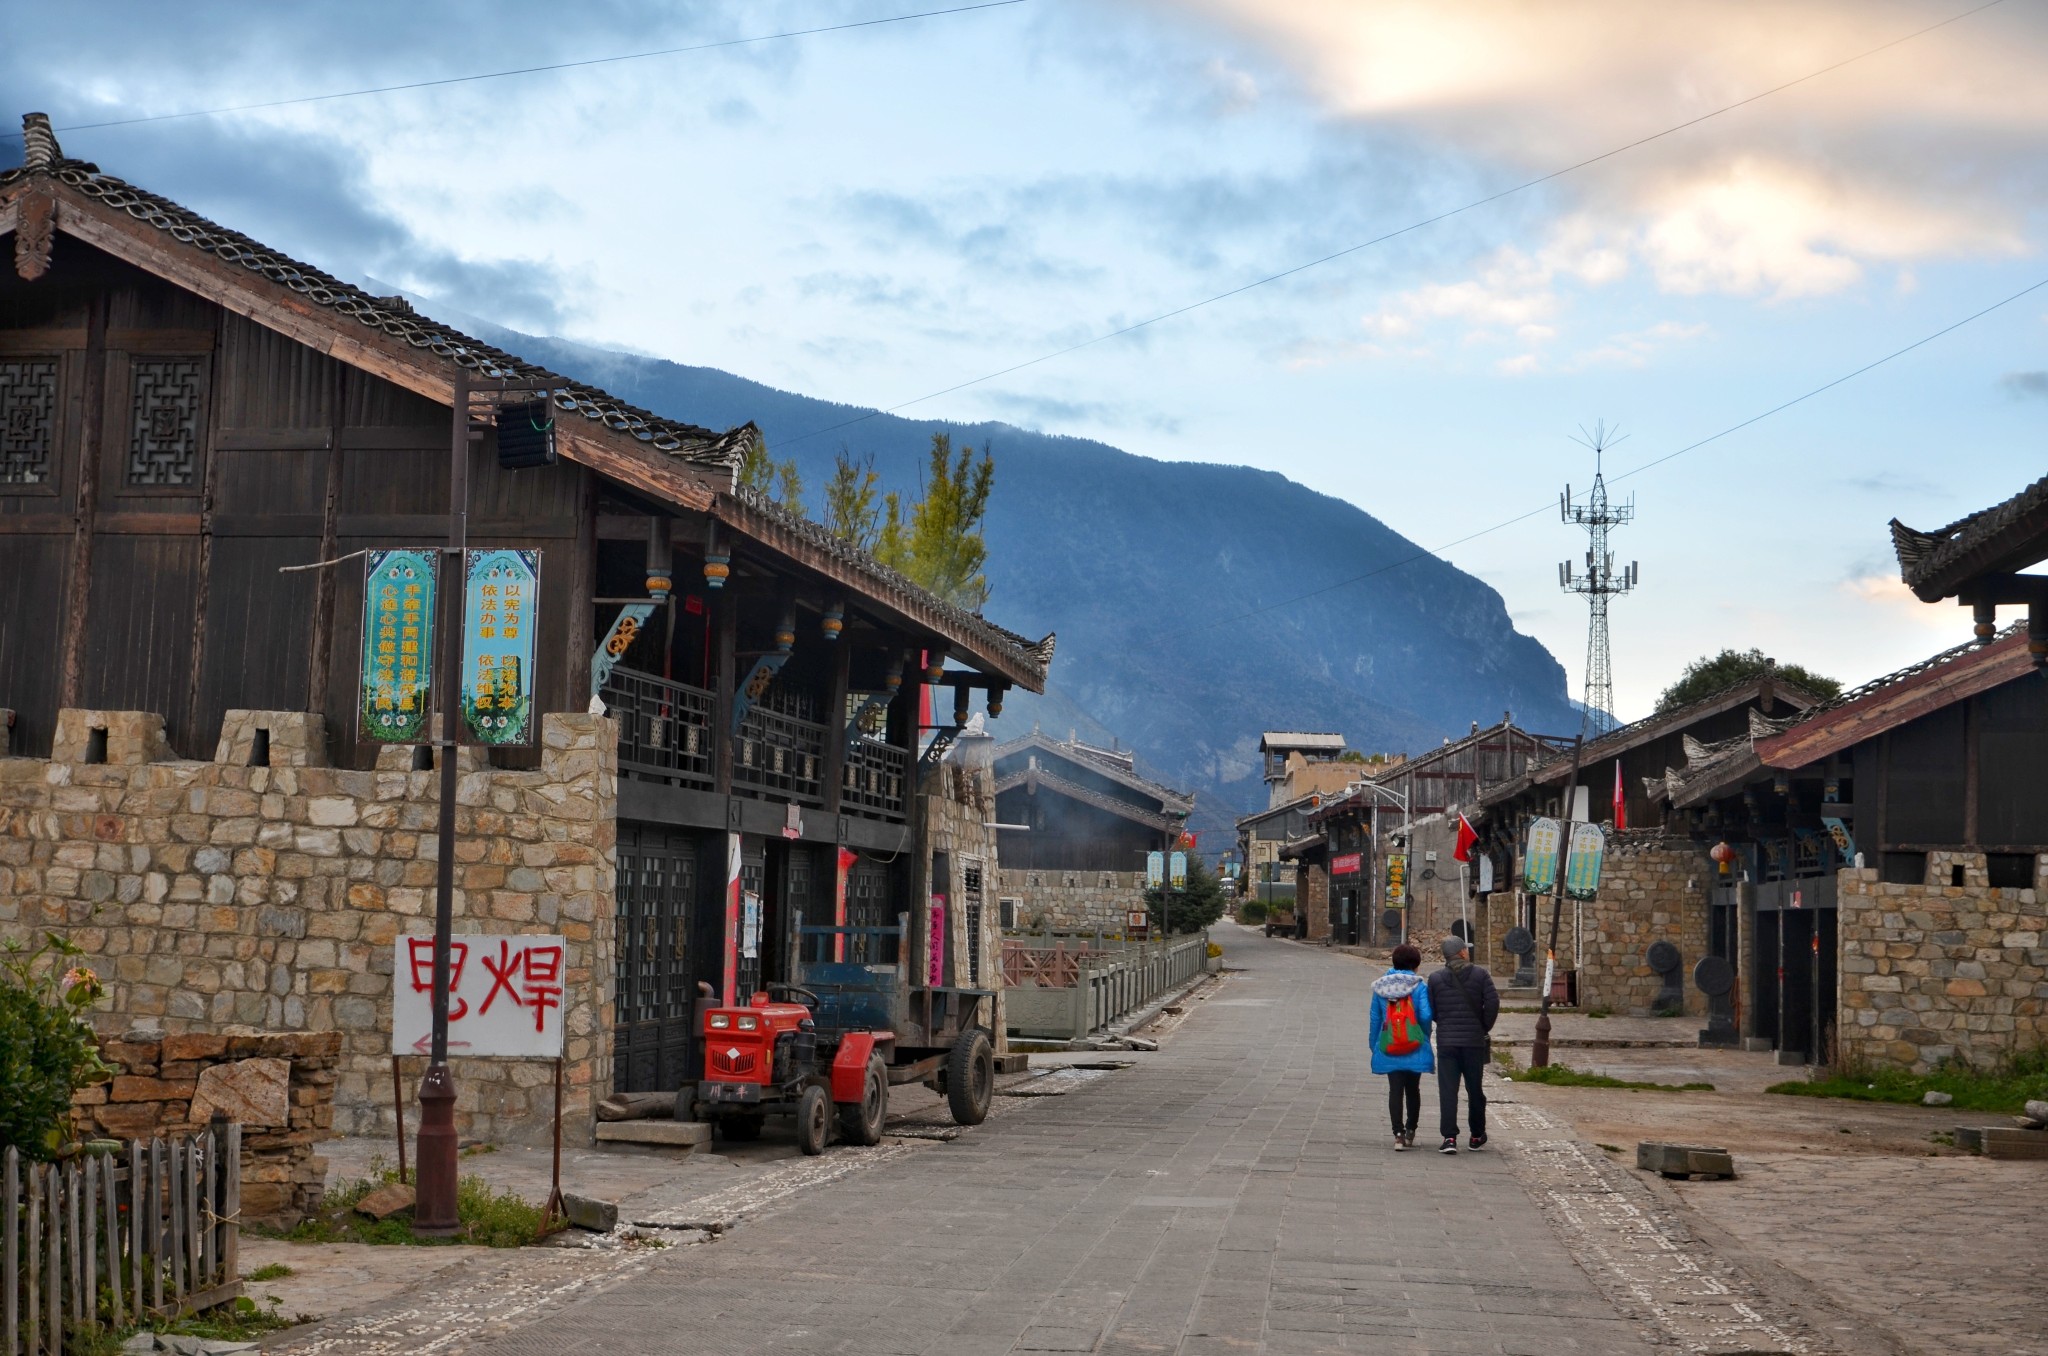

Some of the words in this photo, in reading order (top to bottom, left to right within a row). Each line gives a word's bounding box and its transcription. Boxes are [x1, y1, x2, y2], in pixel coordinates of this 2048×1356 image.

[480, 585, 498, 639] 依法办事
[503, 585, 520, 639] 以宪为尊
[375, 584, 398, 710] 心连心共做守法公民
[399, 584, 421, 710] 手牵手同建和谐茂县
[474, 655, 494, 709] 依法维权
[498, 655, 518, 710] 以法为本
[408, 935, 562, 1032] 电焊
